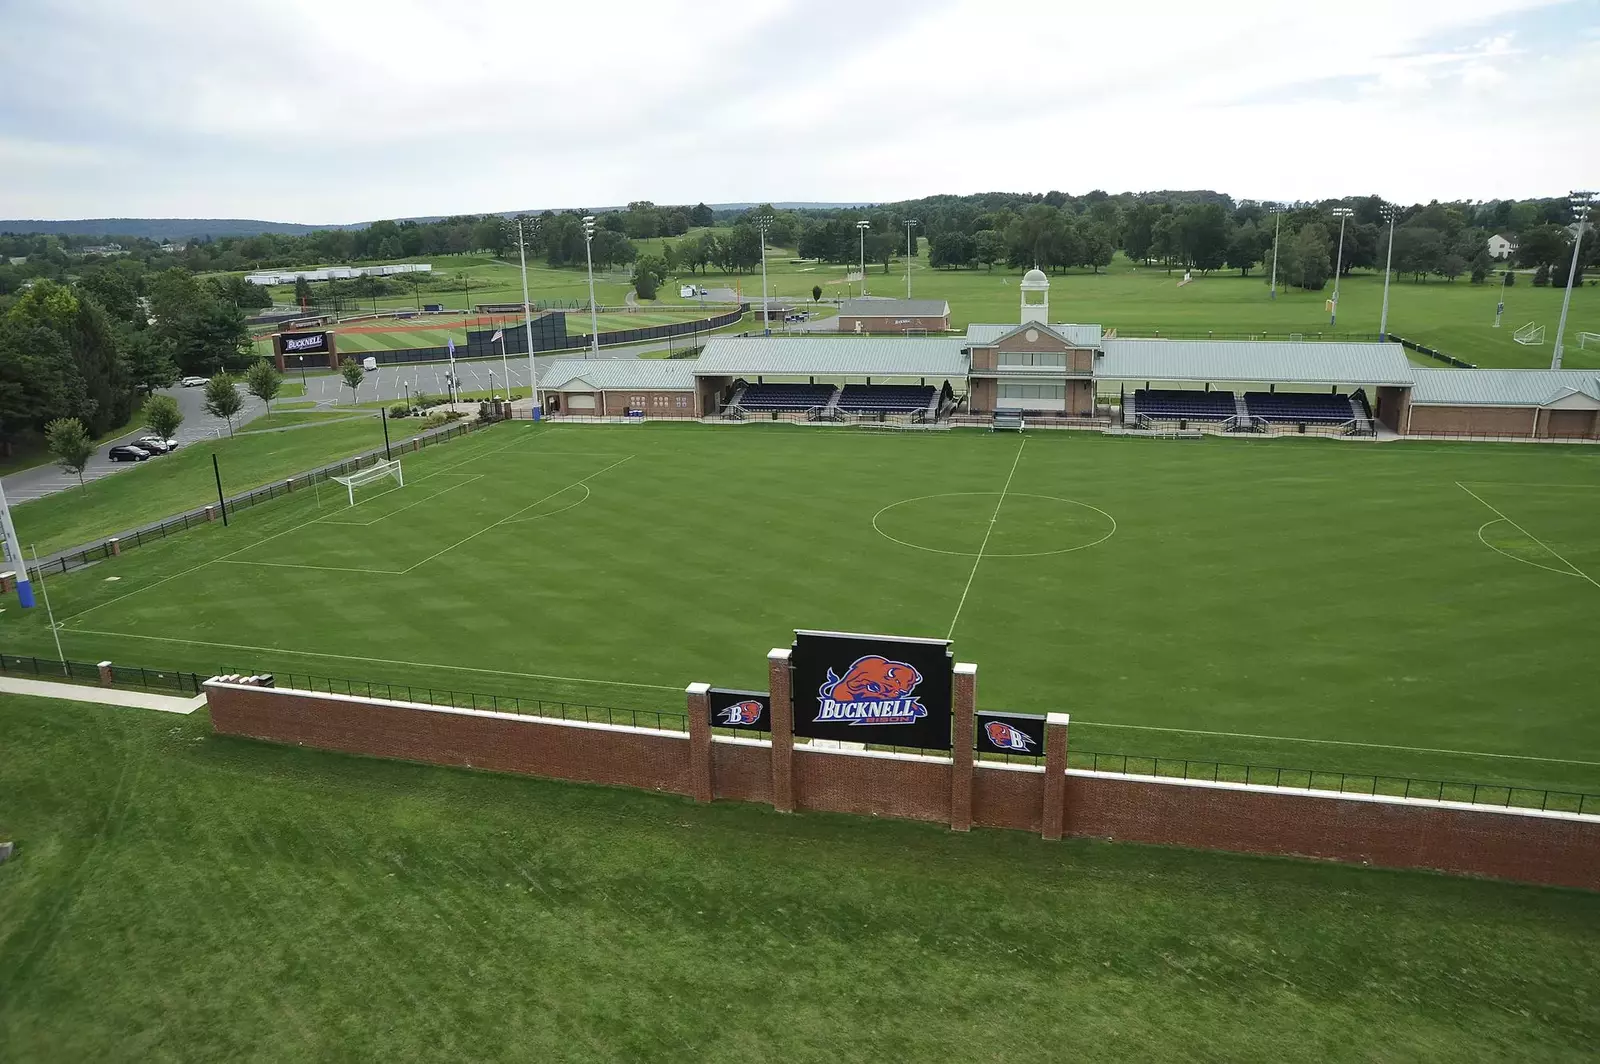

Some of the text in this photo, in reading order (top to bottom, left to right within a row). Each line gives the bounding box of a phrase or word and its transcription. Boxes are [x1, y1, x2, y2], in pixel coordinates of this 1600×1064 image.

[288, 335, 323, 349] BUCKNELL
[729, 705, 742, 723] B
[820, 699, 915, 719] BUCKNELL
[1009, 729, 1024, 748] B
